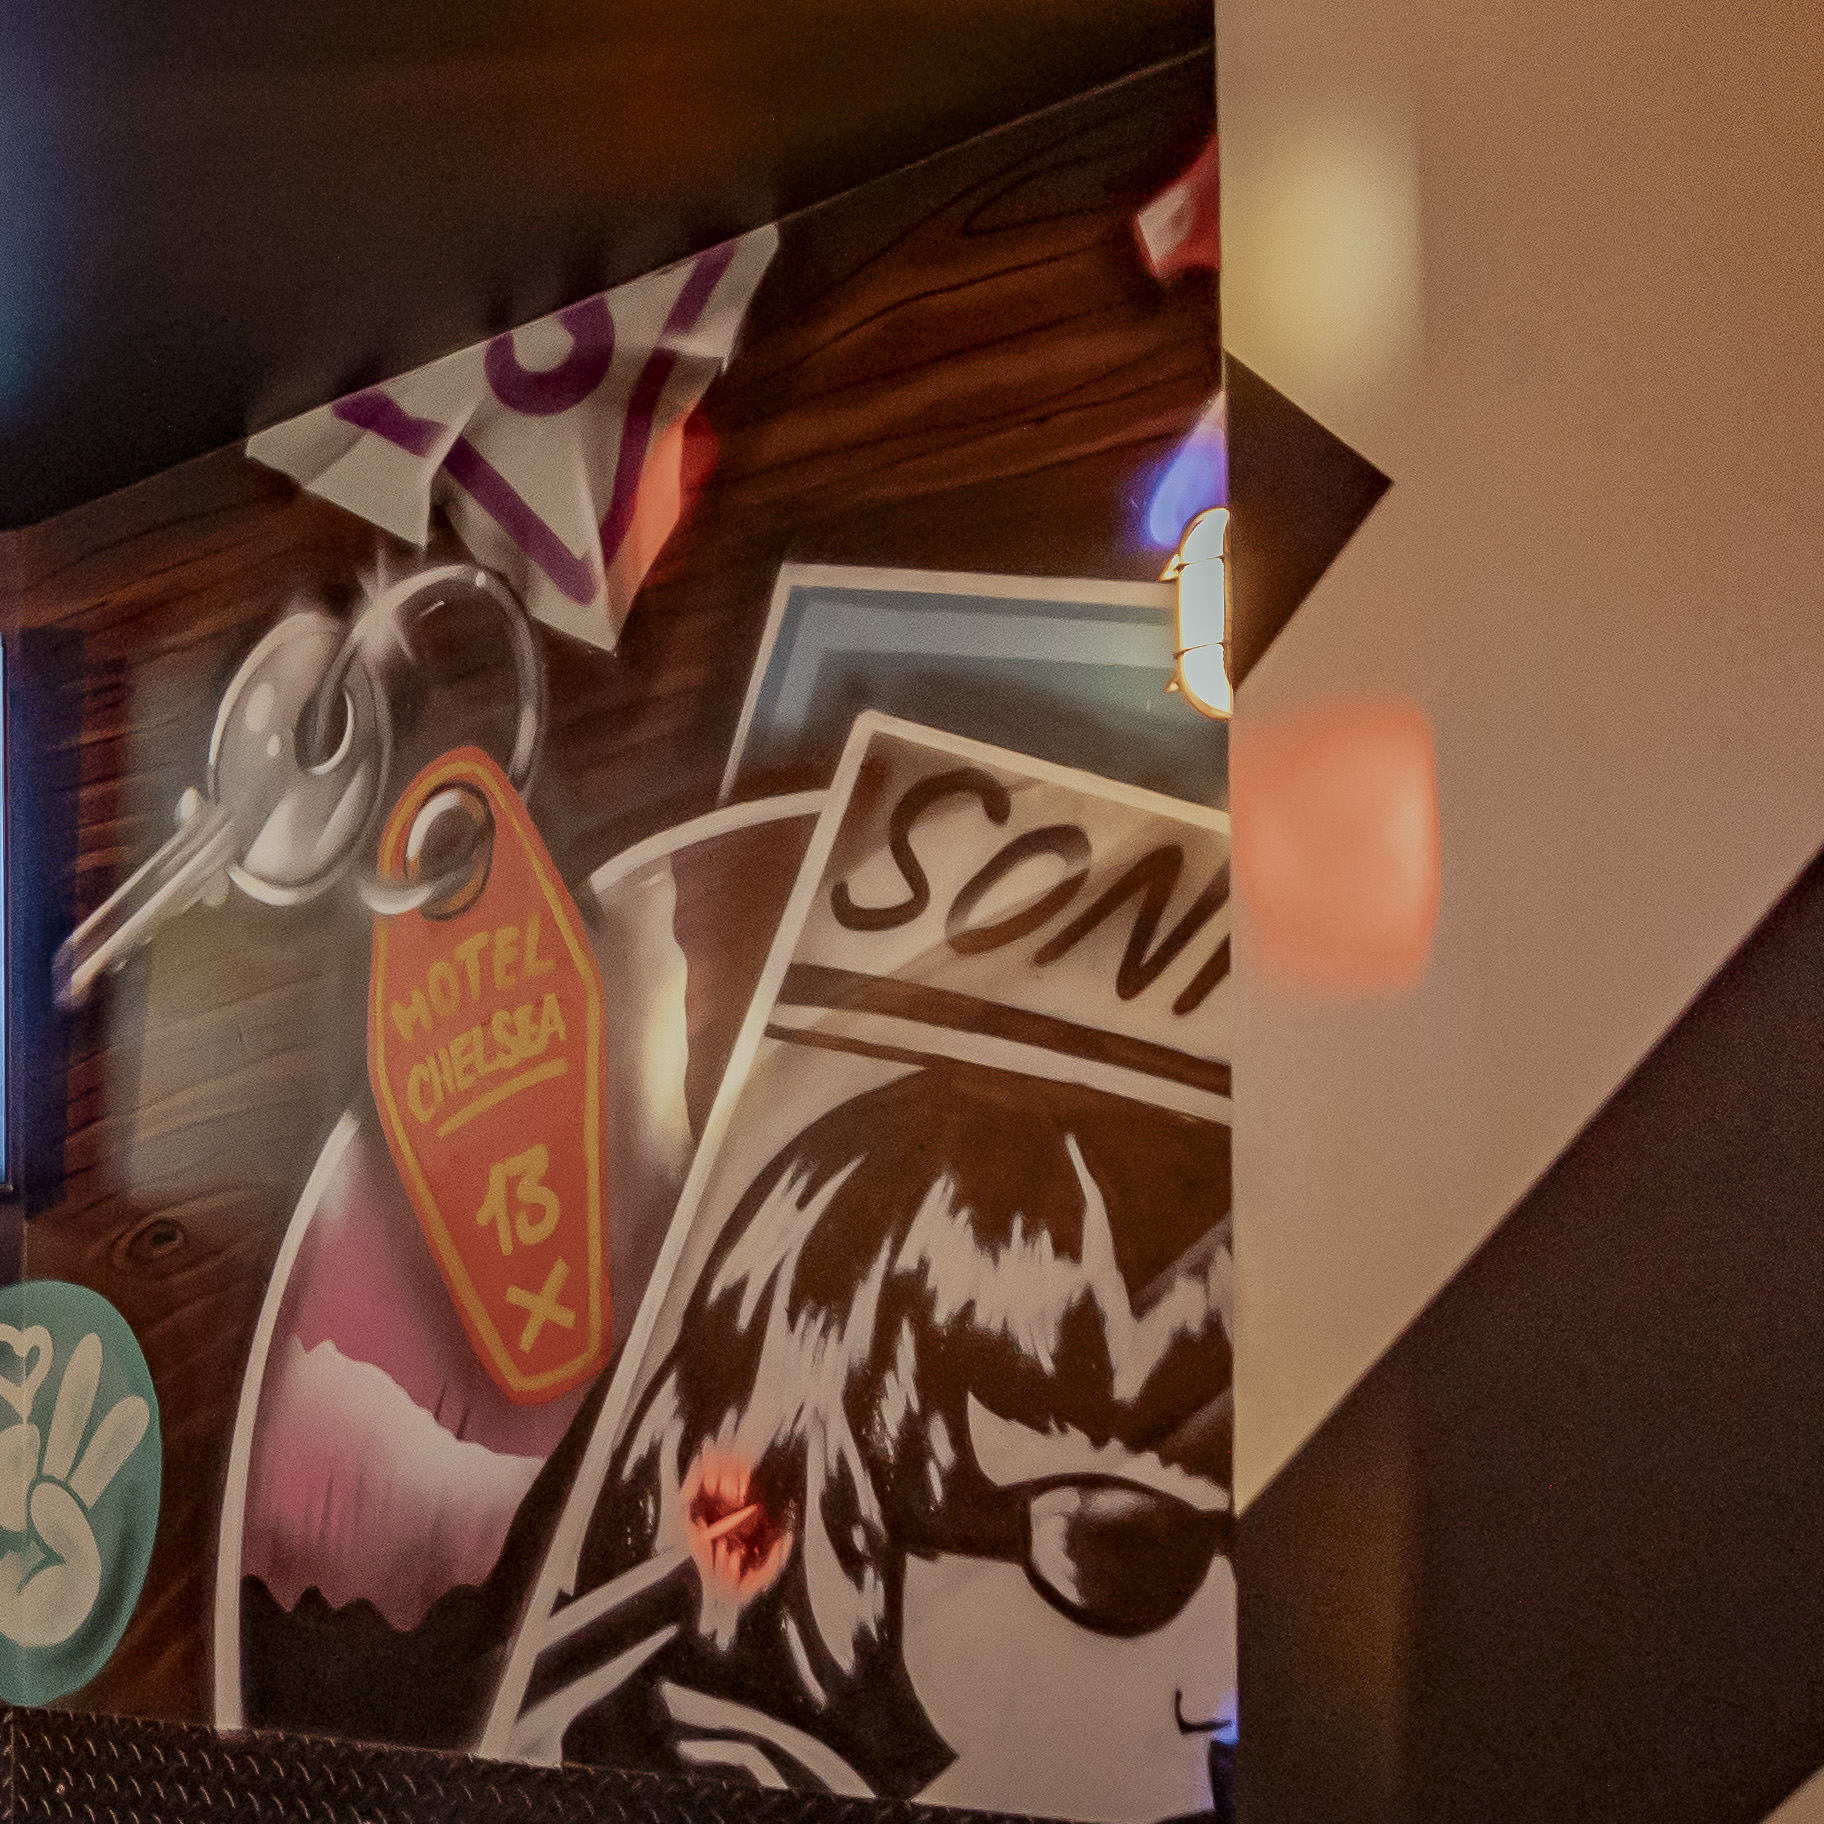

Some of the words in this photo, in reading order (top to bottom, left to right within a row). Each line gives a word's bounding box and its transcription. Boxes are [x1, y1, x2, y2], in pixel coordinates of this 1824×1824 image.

[390, 913, 555, 1043] HOTEL
[407, 993, 566, 1124] CHELSEA
[476, 1144, 560, 1256] 13
